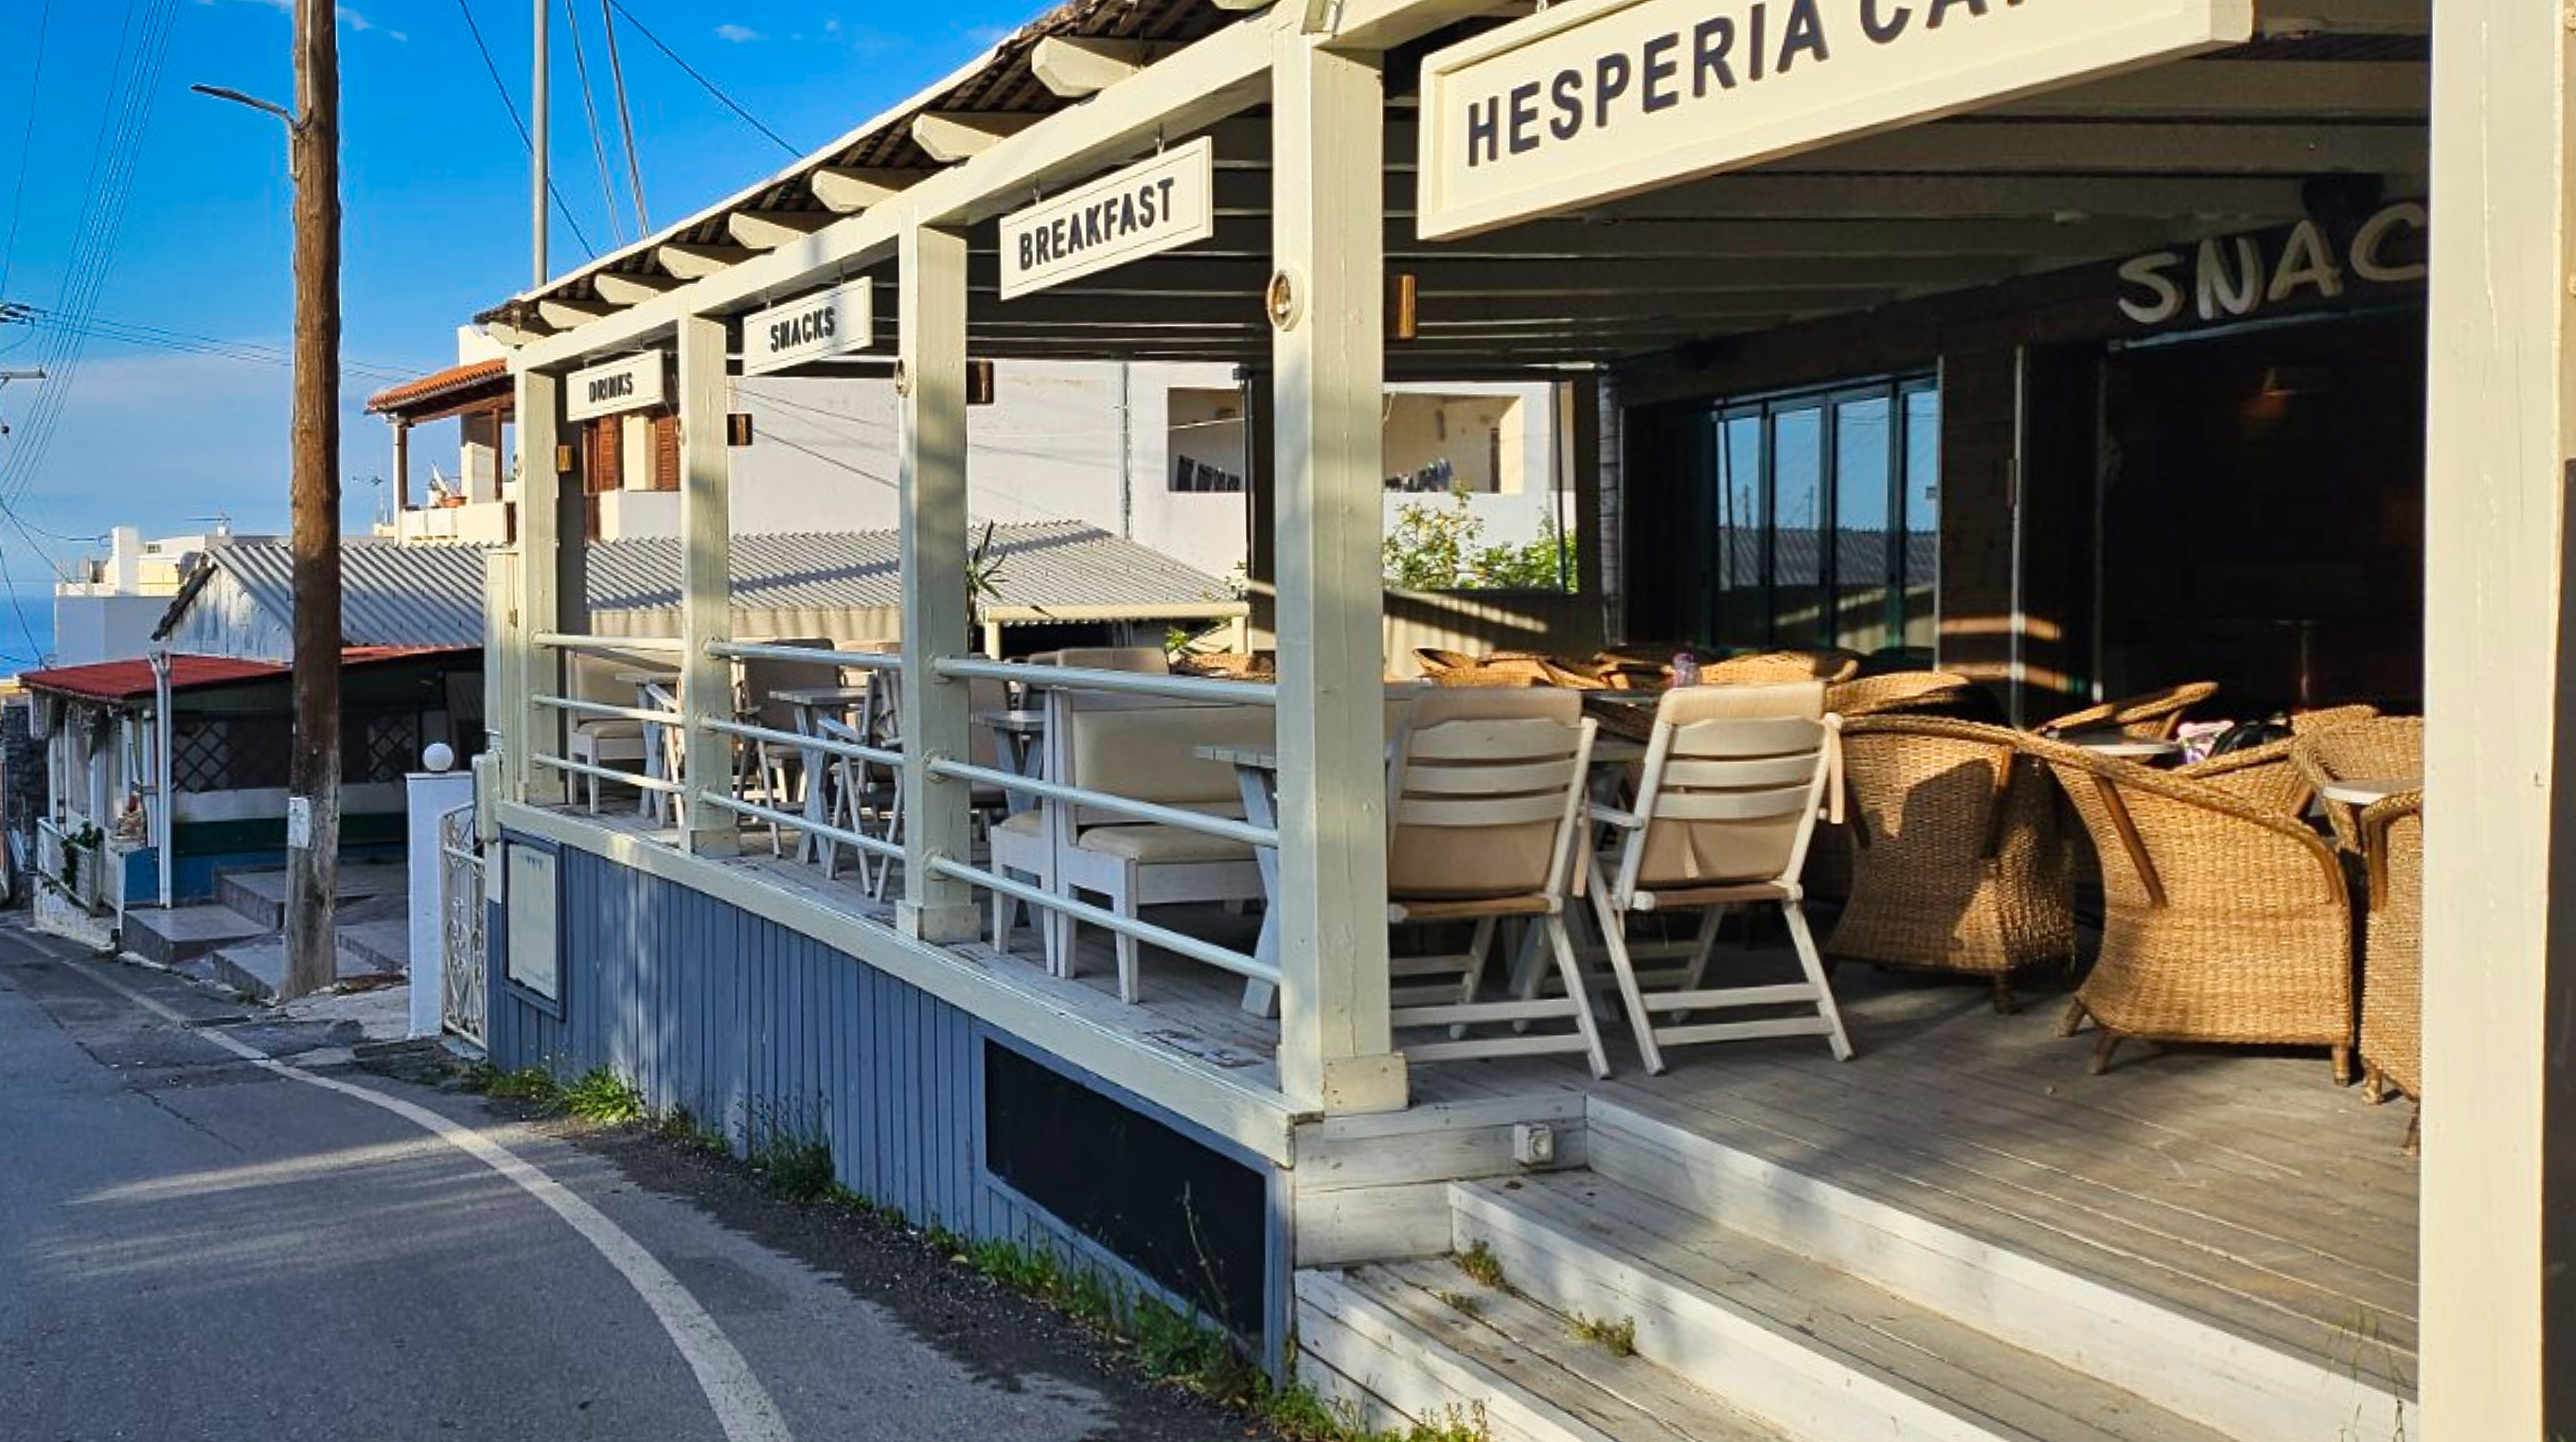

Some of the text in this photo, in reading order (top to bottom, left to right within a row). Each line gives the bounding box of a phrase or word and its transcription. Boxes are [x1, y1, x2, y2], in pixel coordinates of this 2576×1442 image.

[1468, 0, 1829, 167] HESPERIA
[1020, 177, 1174, 271] BREAKFAST
[771, 306, 835, 353] SNACKS
[589, 372, 632, 403] DRINKS
